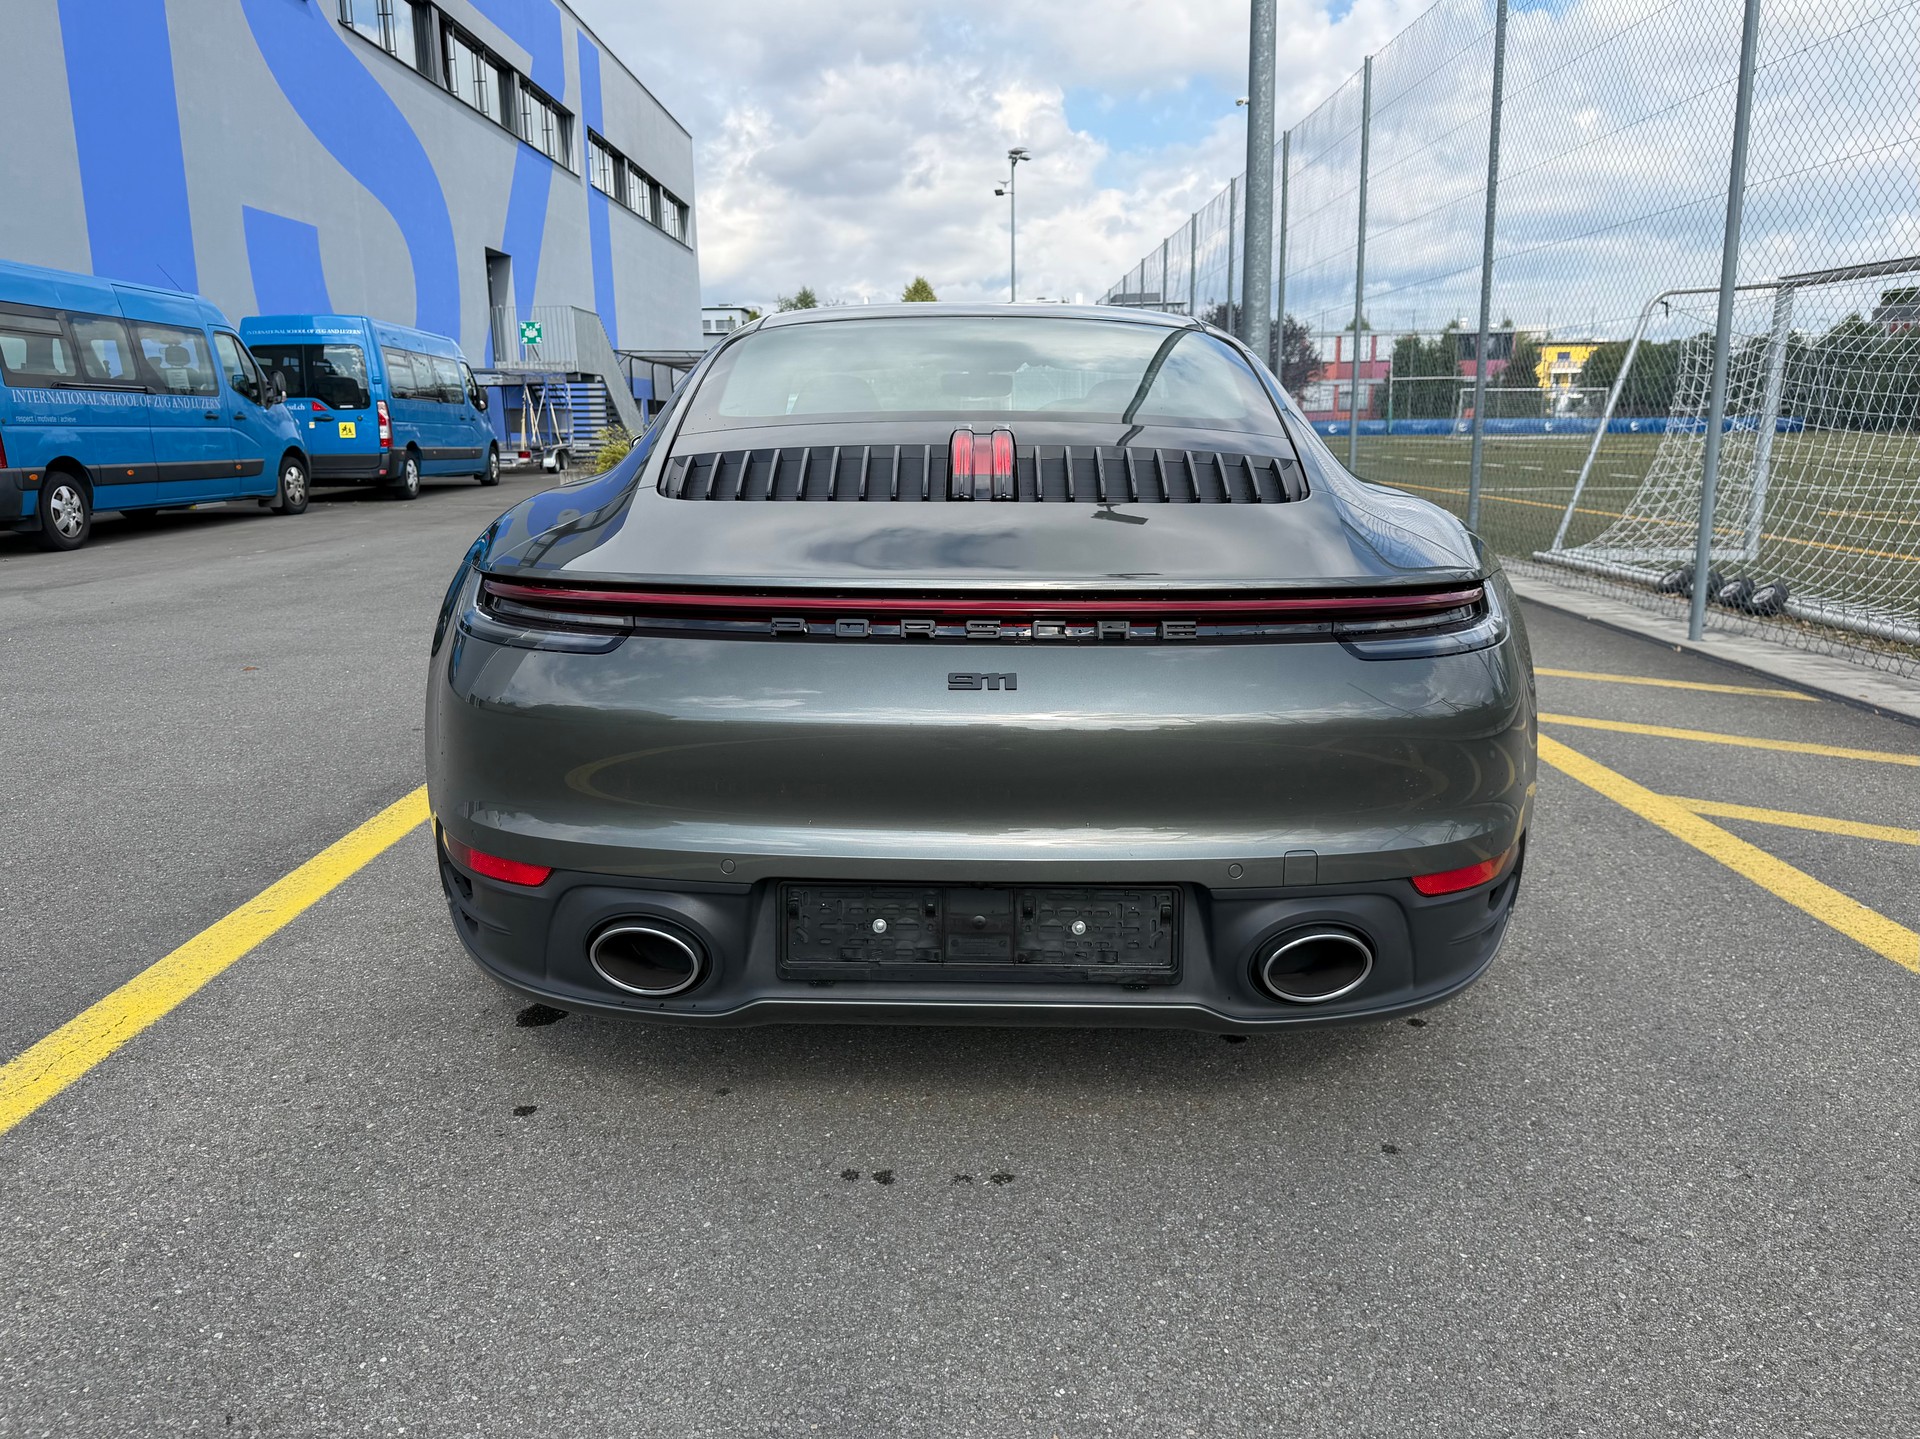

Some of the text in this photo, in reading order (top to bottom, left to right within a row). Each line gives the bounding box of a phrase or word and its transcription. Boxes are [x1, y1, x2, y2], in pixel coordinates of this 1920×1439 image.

[12, 389, 221, 409] INTERNATIONAL SCHOOL OF ZUG AND LUZERN
[15, 415, 34, 423] respect
[37, 415, 57, 423] motivate
[770, 617, 1198, 640] PORSCHE
[947, 672, 1018, 690] 911
